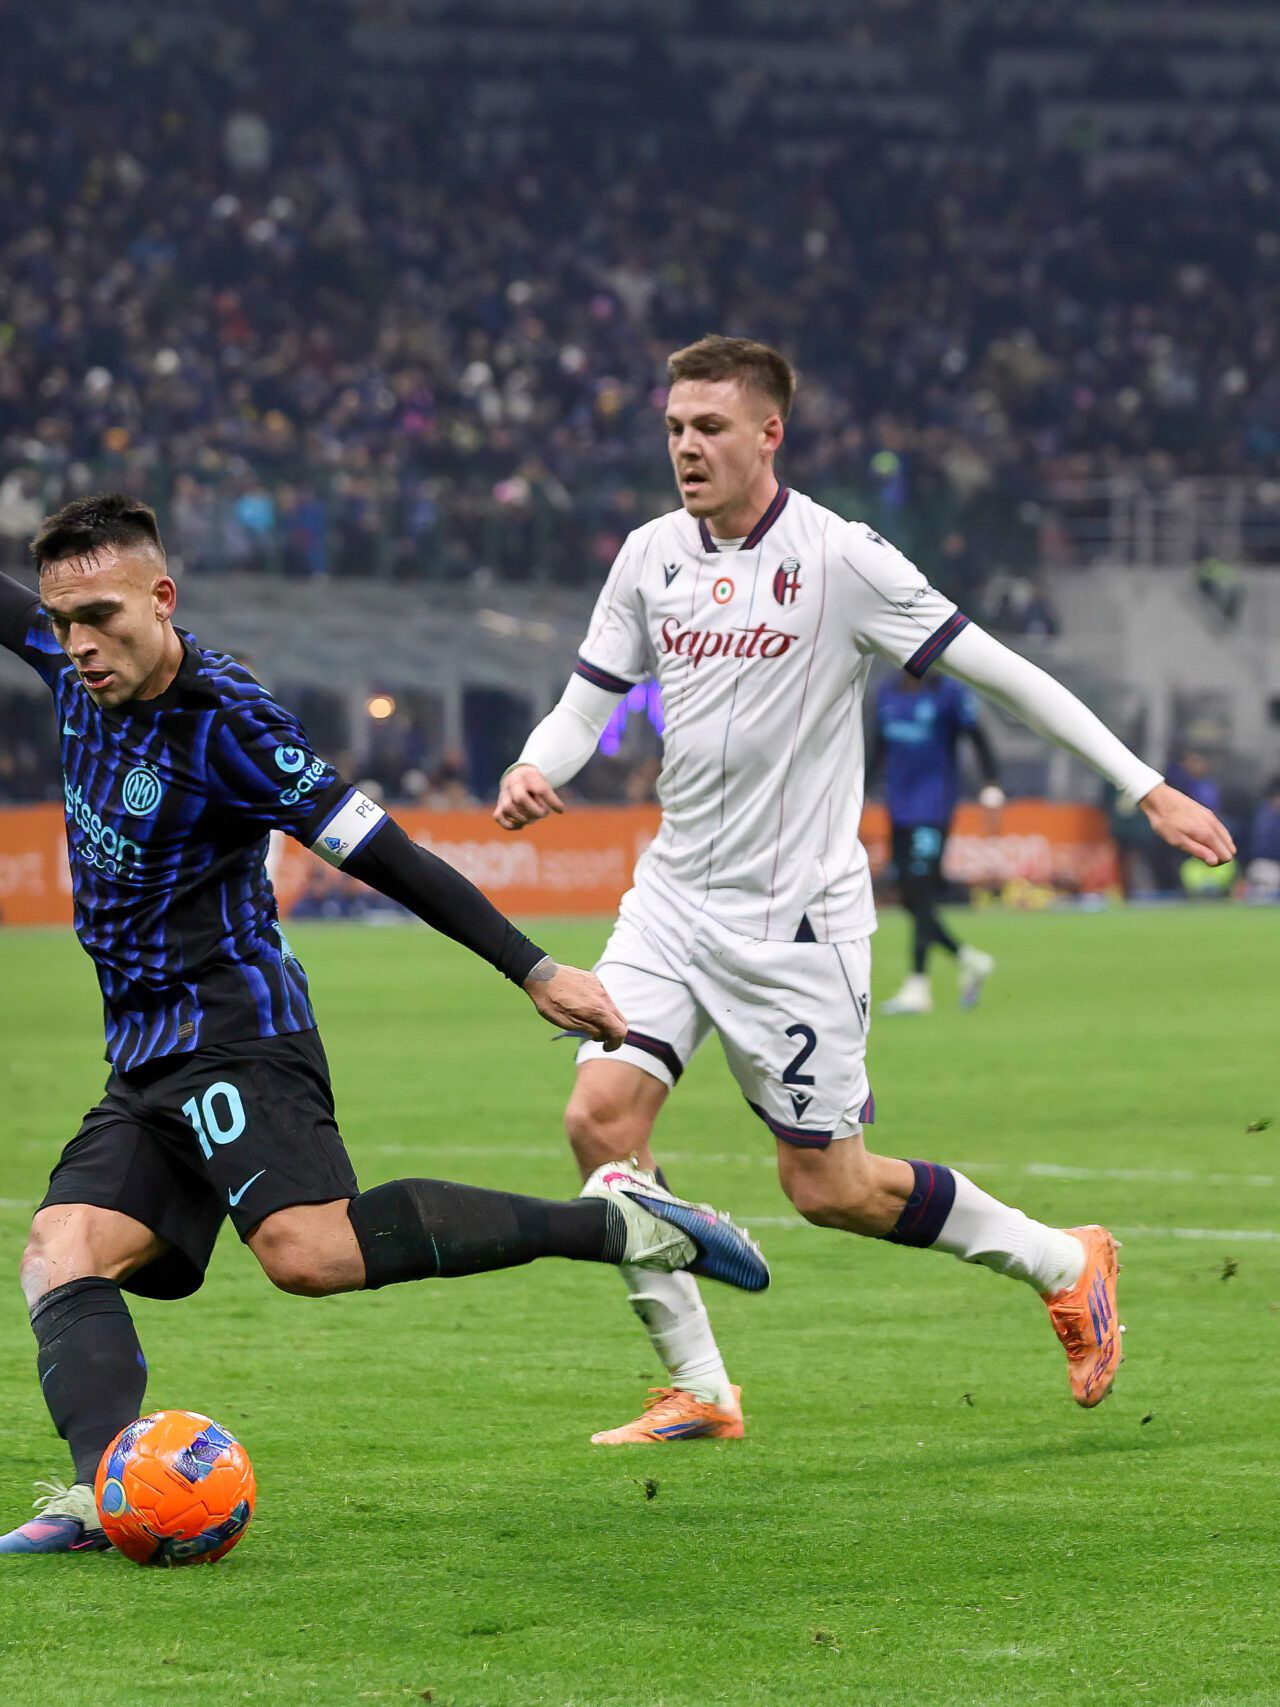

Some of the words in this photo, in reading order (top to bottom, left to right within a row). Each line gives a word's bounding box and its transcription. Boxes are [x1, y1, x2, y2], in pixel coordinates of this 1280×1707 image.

[657, 617, 799, 669] Saputo
[782, 1023, 818, 1086] 2
[181, 1081, 246, 1161] 10
